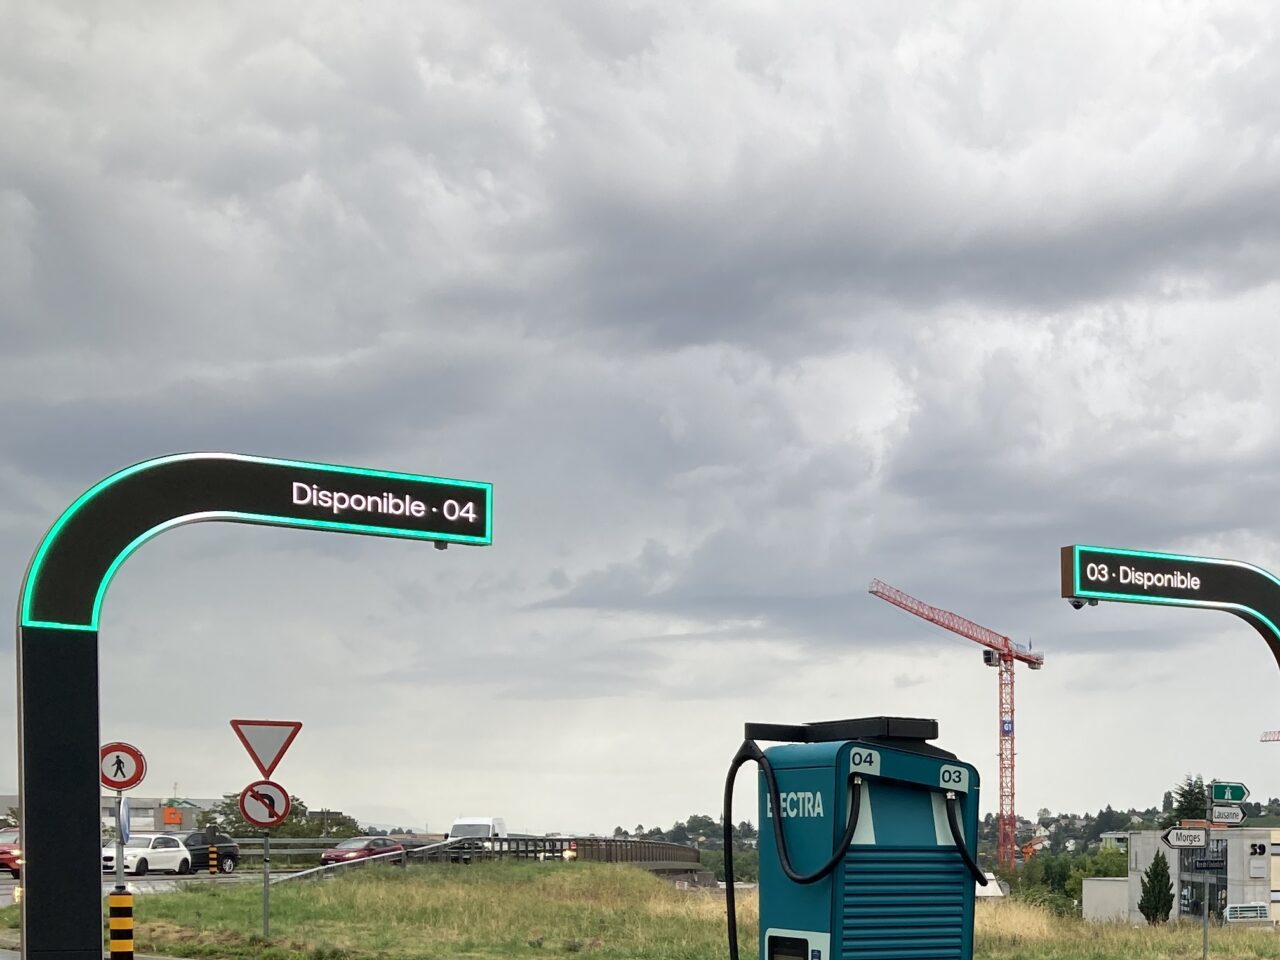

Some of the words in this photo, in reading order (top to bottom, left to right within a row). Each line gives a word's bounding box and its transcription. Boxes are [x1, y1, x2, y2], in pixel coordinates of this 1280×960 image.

[292, 481, 426, 517] Disponible
[443, 499, 478, 523] 04
[1086, 562, 1109, 582] 03
[1119, 565, 1201, 590] Disponible
[851, 751, 875, 767] 04
[941, 769, 962, 784] 03
[767, 790, 824, 818] EECTRA
[1214, 810, 1239, 820] Lausanne
[1175, 832, 1200, 845] Morges
[1250, 843, 1266, 856] 59
